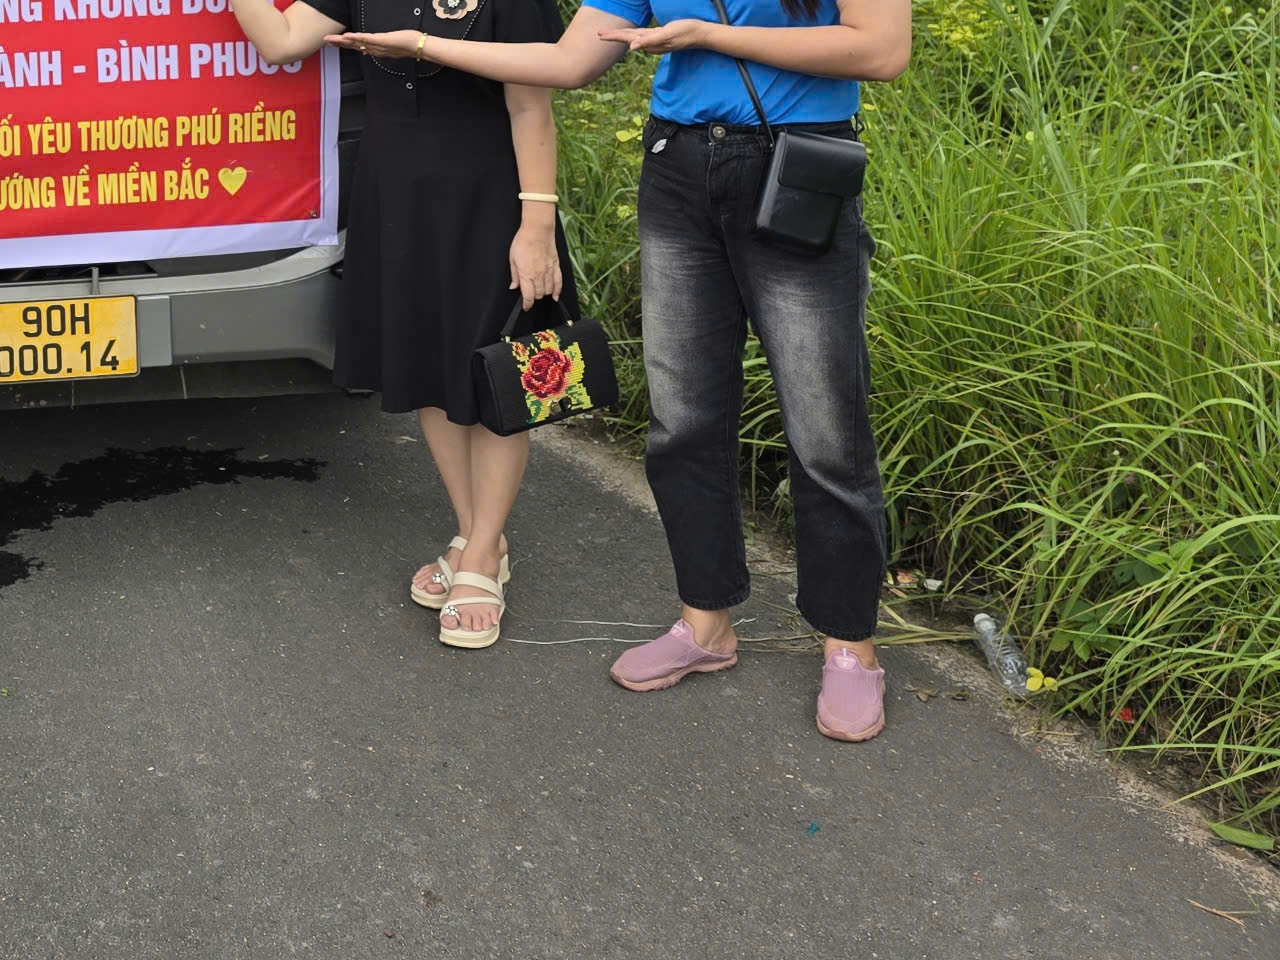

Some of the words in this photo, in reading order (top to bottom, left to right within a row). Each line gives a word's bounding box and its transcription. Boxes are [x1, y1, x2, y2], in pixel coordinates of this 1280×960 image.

[73, 65, 86, 74] -
[97, 40, 178, 83] BÌNH
[28, 117, 70, 154] YÊU
[78, 115, 168, 152] THƯƠNG
[177, 108, 221, 146] PHÚ
[229, 102, 295, 143] RIỀNG
[63, 165, 90, 206] VỀ
[98, 163, 156, 204] MIỀN
[165, 158, 209, 200] BẮC
[22, 303, 90, 338] 90H
